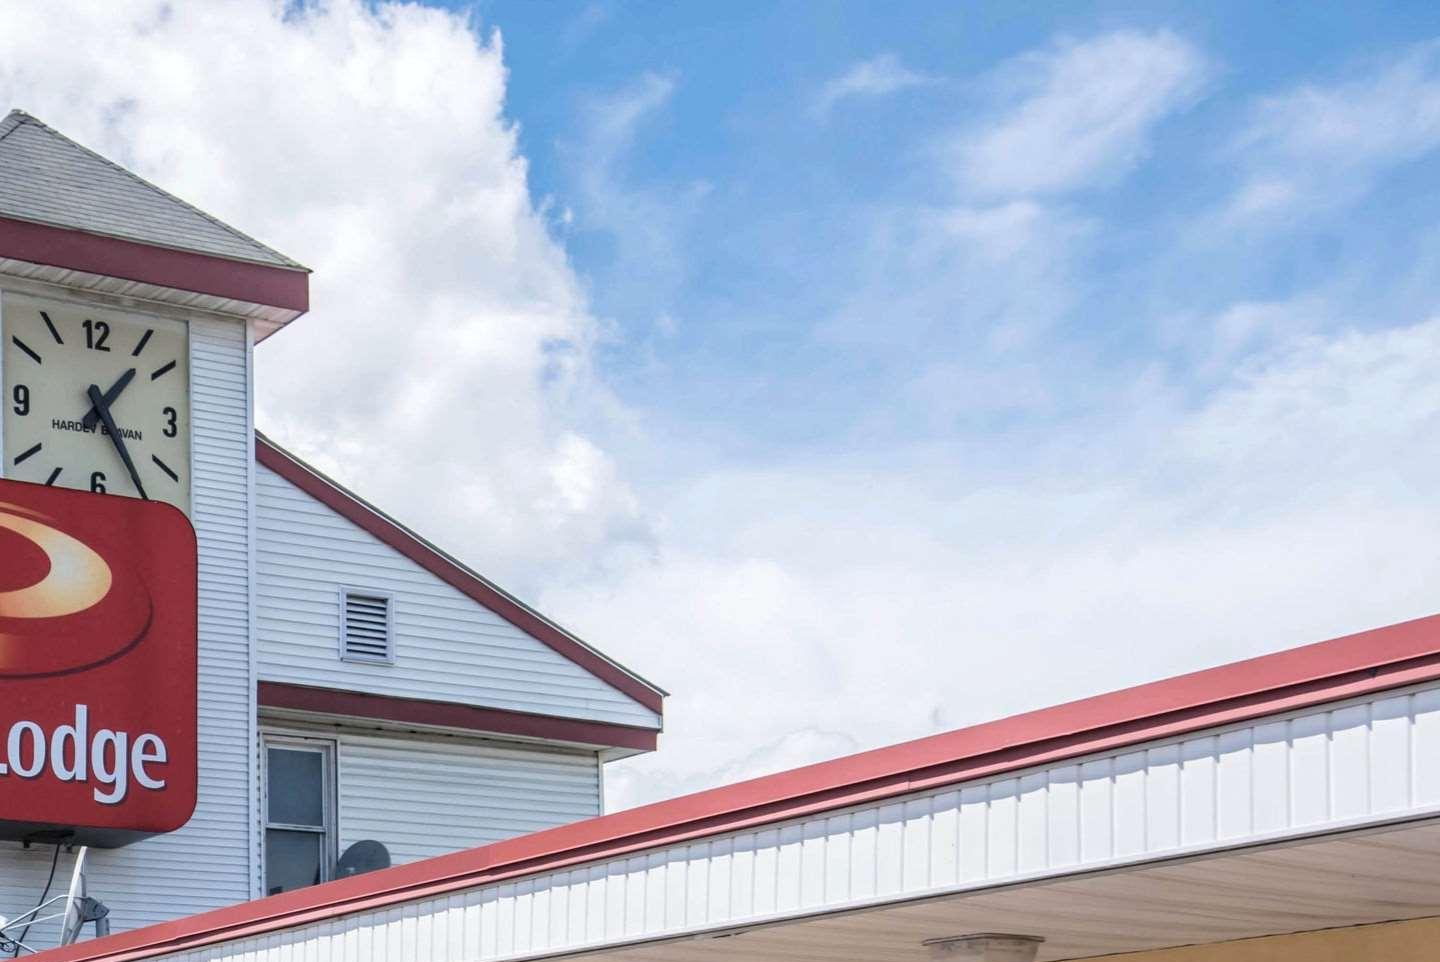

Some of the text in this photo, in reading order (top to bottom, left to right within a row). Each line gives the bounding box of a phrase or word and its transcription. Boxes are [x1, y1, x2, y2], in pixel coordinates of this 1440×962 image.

[82, 319, 111, 352] 12
[13, 384, 30, 416] 9
[52, 419, 142, 440] HARDEV BVAN
[162, 406, 177, 438] 3
[90, 471, 106, 494] 6
